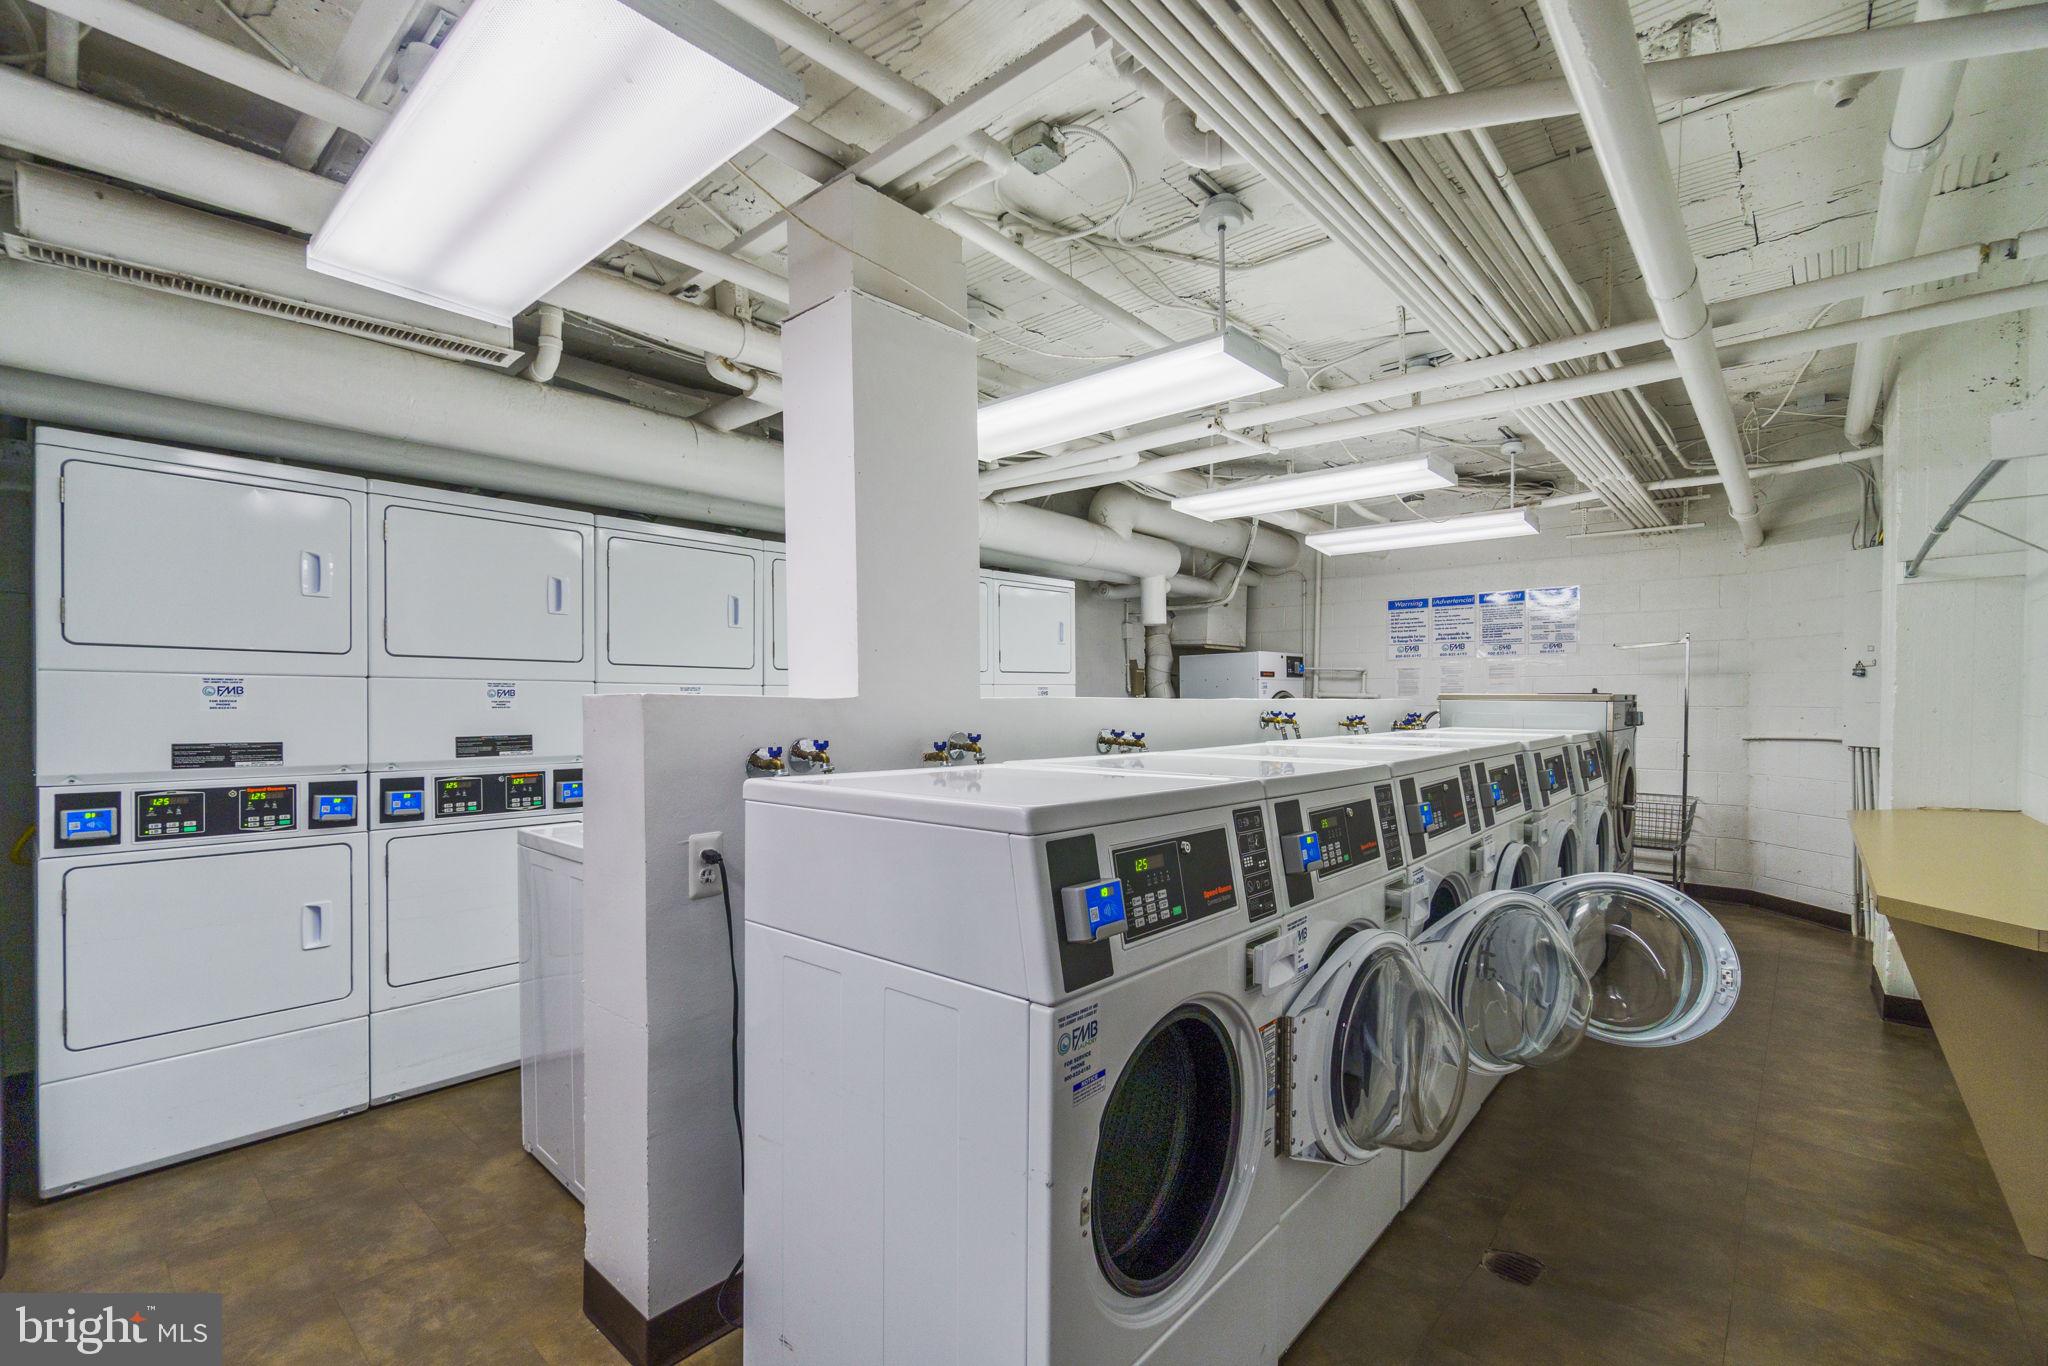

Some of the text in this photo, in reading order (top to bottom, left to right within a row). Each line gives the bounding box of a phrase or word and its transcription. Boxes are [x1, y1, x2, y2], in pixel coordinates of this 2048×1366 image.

[217, 686, 244, 697] FMB
[497, 689, 515, 698] FMB
[1072, 1020, 1098, 1051] FMB
[1064, 1050, 1091, 1068] FOR SERVICE
[1070, 1060, 1085, 1072] PHONE
[1081, 1073, 1099, 1088] NOTICE
